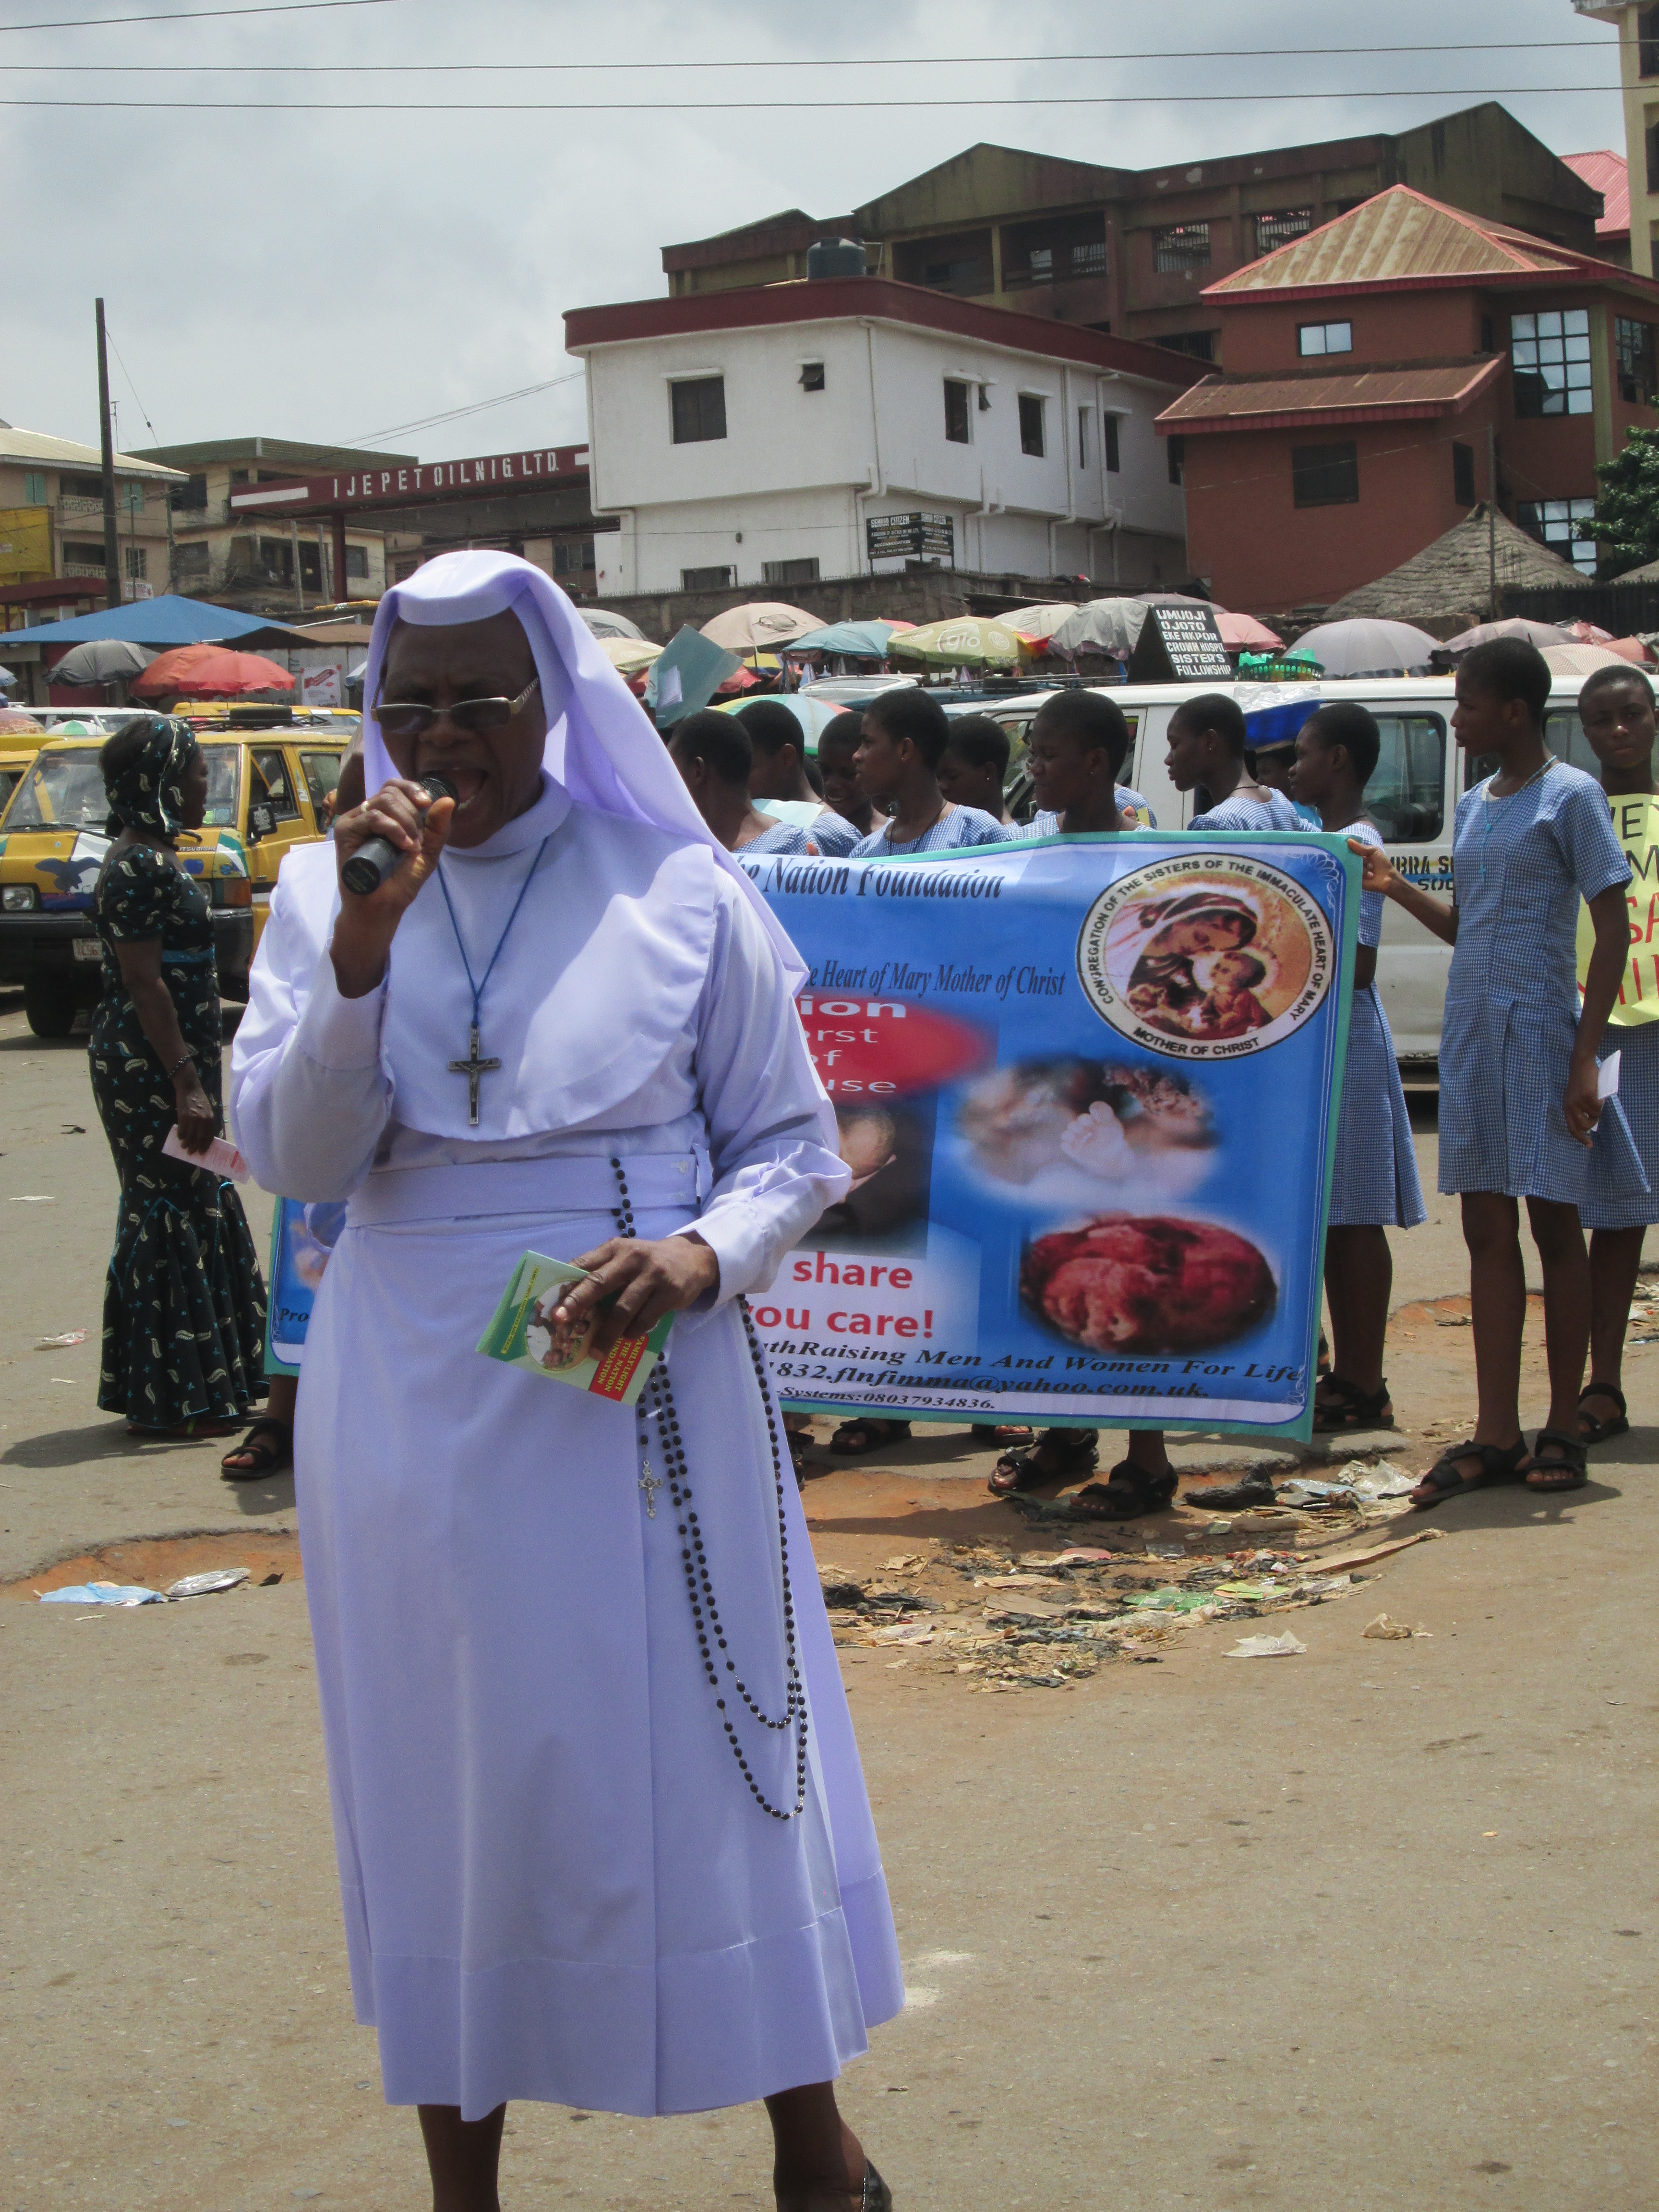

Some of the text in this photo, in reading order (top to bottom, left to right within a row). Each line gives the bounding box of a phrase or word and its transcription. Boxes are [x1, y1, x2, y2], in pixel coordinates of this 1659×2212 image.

[381, 468, 422, 493] PET
[890, 515, 910, 526] CITIZEN
[1155, 609, 1206, 621] UMUOJI
[1160, 621, 1205, 631] OJOTO
[947, 632, 981, 652] glo
[1162, 631, 1218, 641] EKE NKPOR
[1166, 641, 1200, 652] CROWN
[1170, 653, 1225, 663] SISTER'S
[1176, 664, 1231, 676] FOLLOWSHIP
[1143, 860, 1201, 882] SISTERS
[1205, 860, 1223, 869] OF
[1228, 861, 1254, 876] THE
[763, 857, 850, 895] Nation
[855, 863, 1005, 899] Foundation
[1117, 878, 1143, 896] THE
[1104, 896, 1118, 912] OF
[1256, 869, 1321, 929] IMMACULATE
[1312, 931, 1326, 971] HEART
[820, 960, 867, 988] Heart
[869, 962, 890, 997] of
[888, 963, 932, 998] Mary
[933, 964, 993, 993] Mother
[996, 965, 1016, 1001] of
[1016, 966, 1067, 996] Christ
[1312, 973, 1324, 989] OF
[1289, 989, 1317, 1021] MARY
[1133, 1027, 1260, 1055] MOTHER OF CHRIST
[793, 1251, 913, 1289] share
[280, 1308, 309, 1322] Pro
[827, 1310, 933, 1339] care!
[604, 1342, 632, 1392] THE NATION
[914, 1349, 981, 1367] Men
[992, 1354, 1054, 1370] And
[1066, 1357, 1169, 1374] Women
[1179, 1360, 1236, 1376] For
[1244, 1362, 1301, 1382] Life
